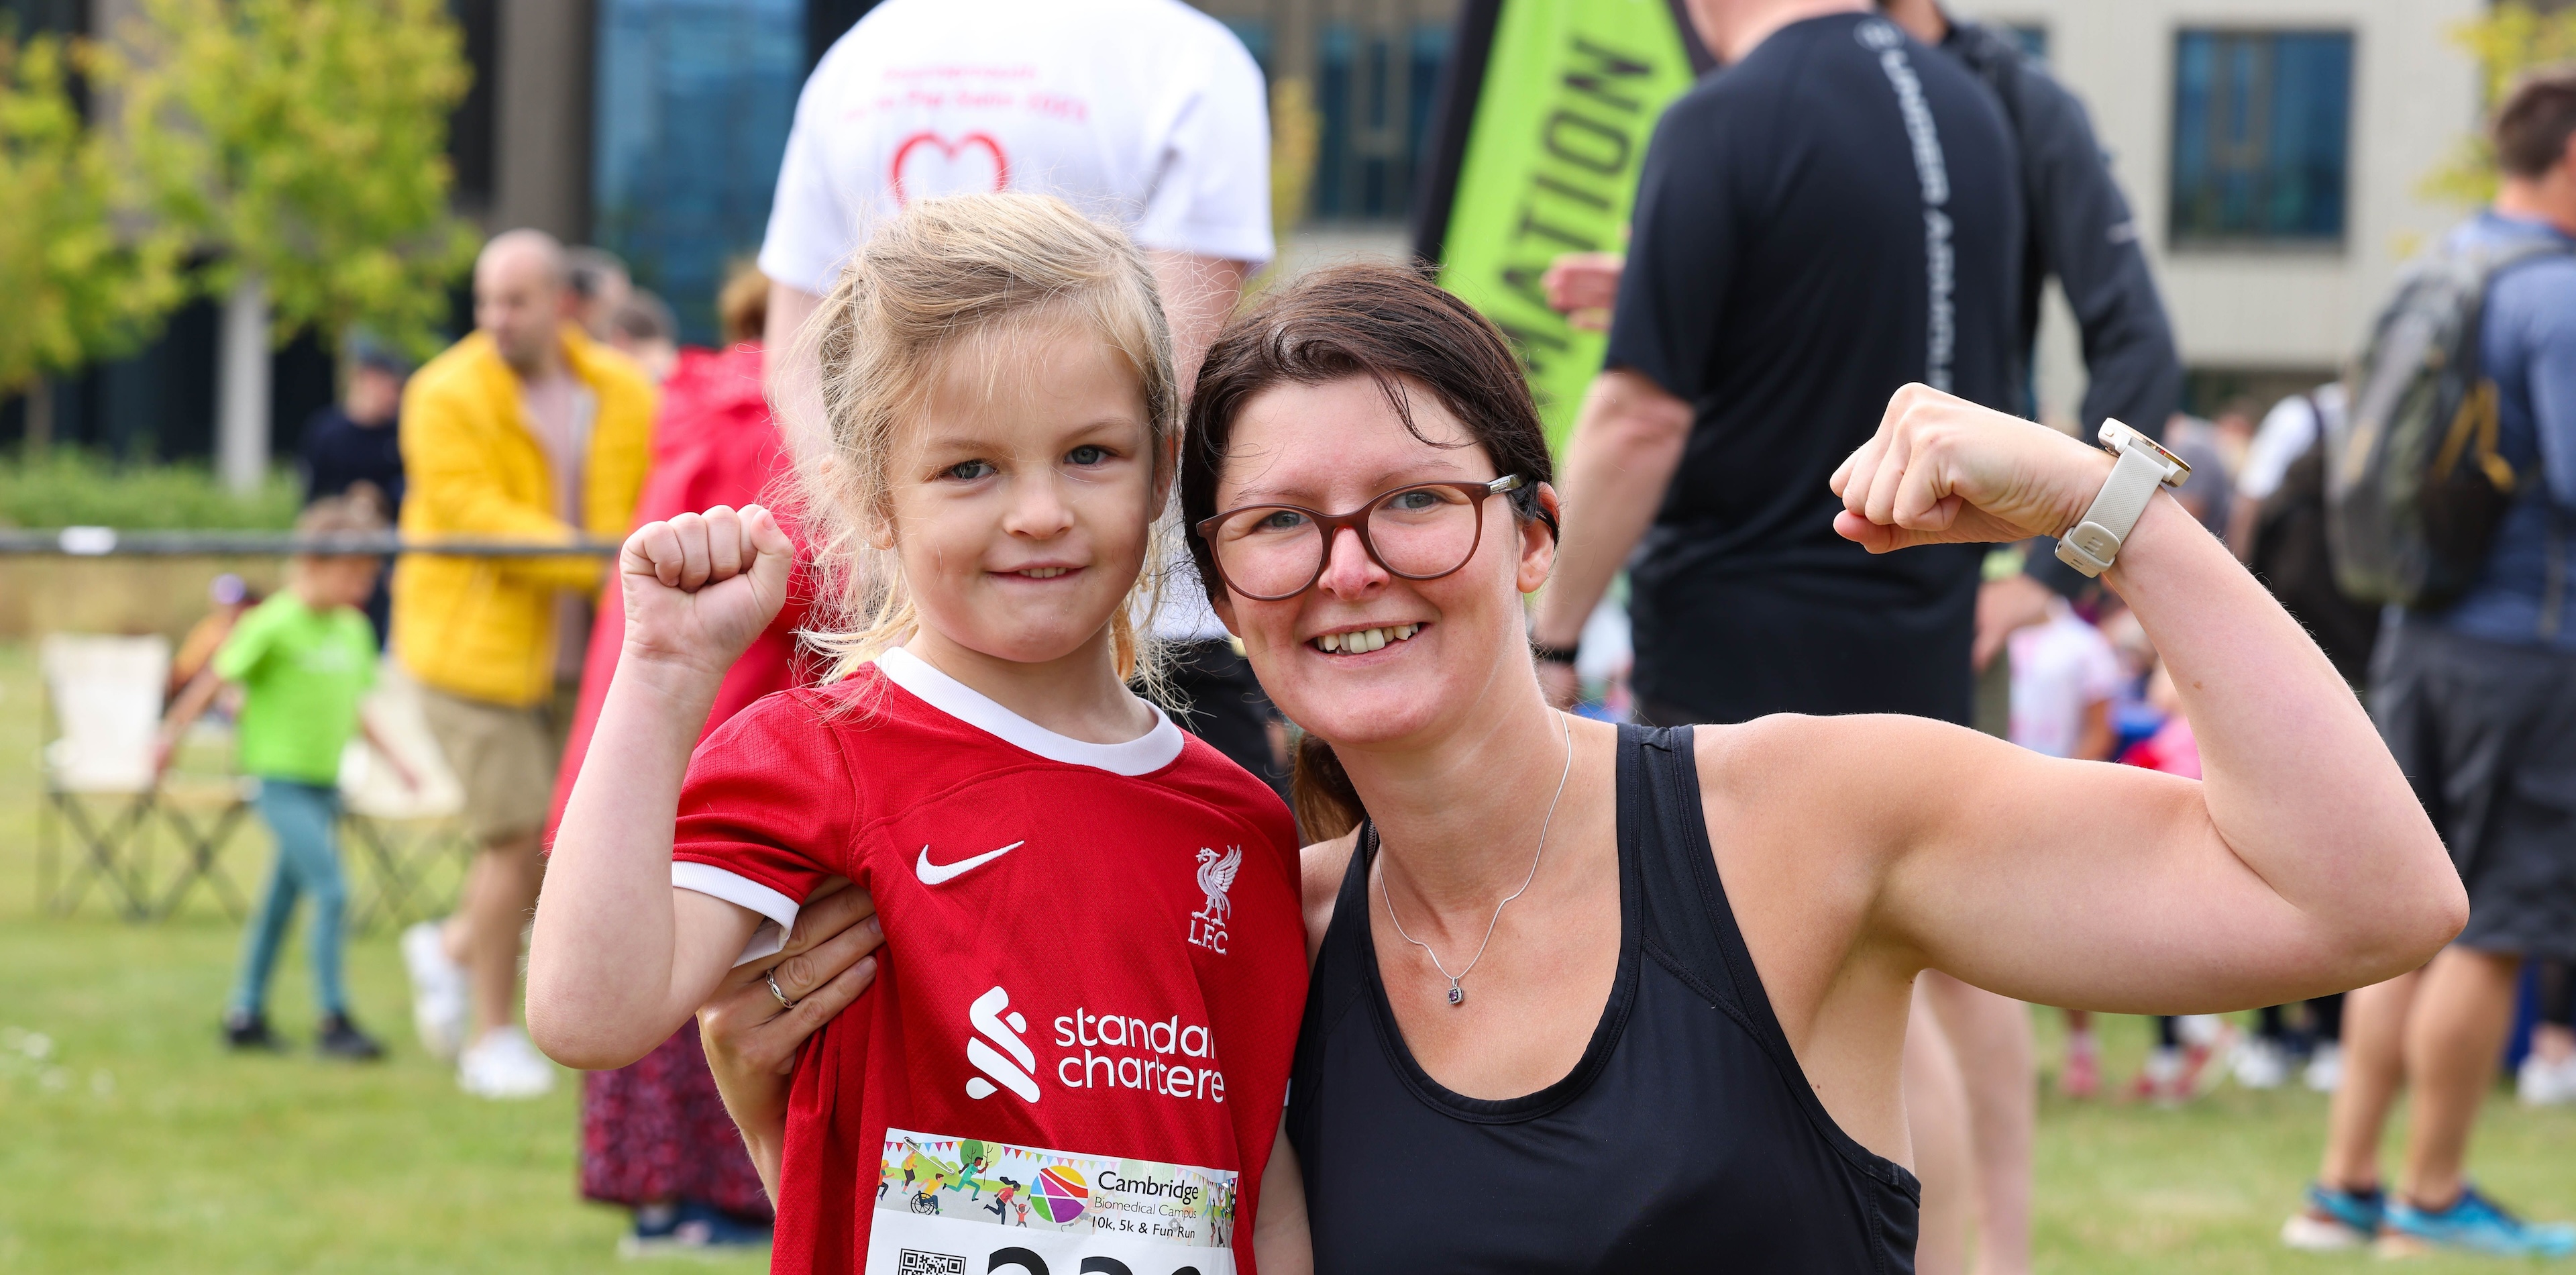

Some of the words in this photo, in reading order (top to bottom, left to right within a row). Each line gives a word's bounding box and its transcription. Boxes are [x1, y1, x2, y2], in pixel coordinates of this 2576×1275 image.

[1879, 49, 1951, 205] UNDER
[1098, 1171, 1199, 1205] Cambridge
[1095, 1196, 1156, 1215] Biomedical
[1159, 1205, 1197, 1221] Campus
[1092, 1216, 1115, 1231] 10k,
[1119, 1219, 1134, 1232] 5k
[1138, 1223, 1148, 1234] &
[1153, 1224, 1173, 1237] Fun
[1177, 1226, 1195, 1239] Run
